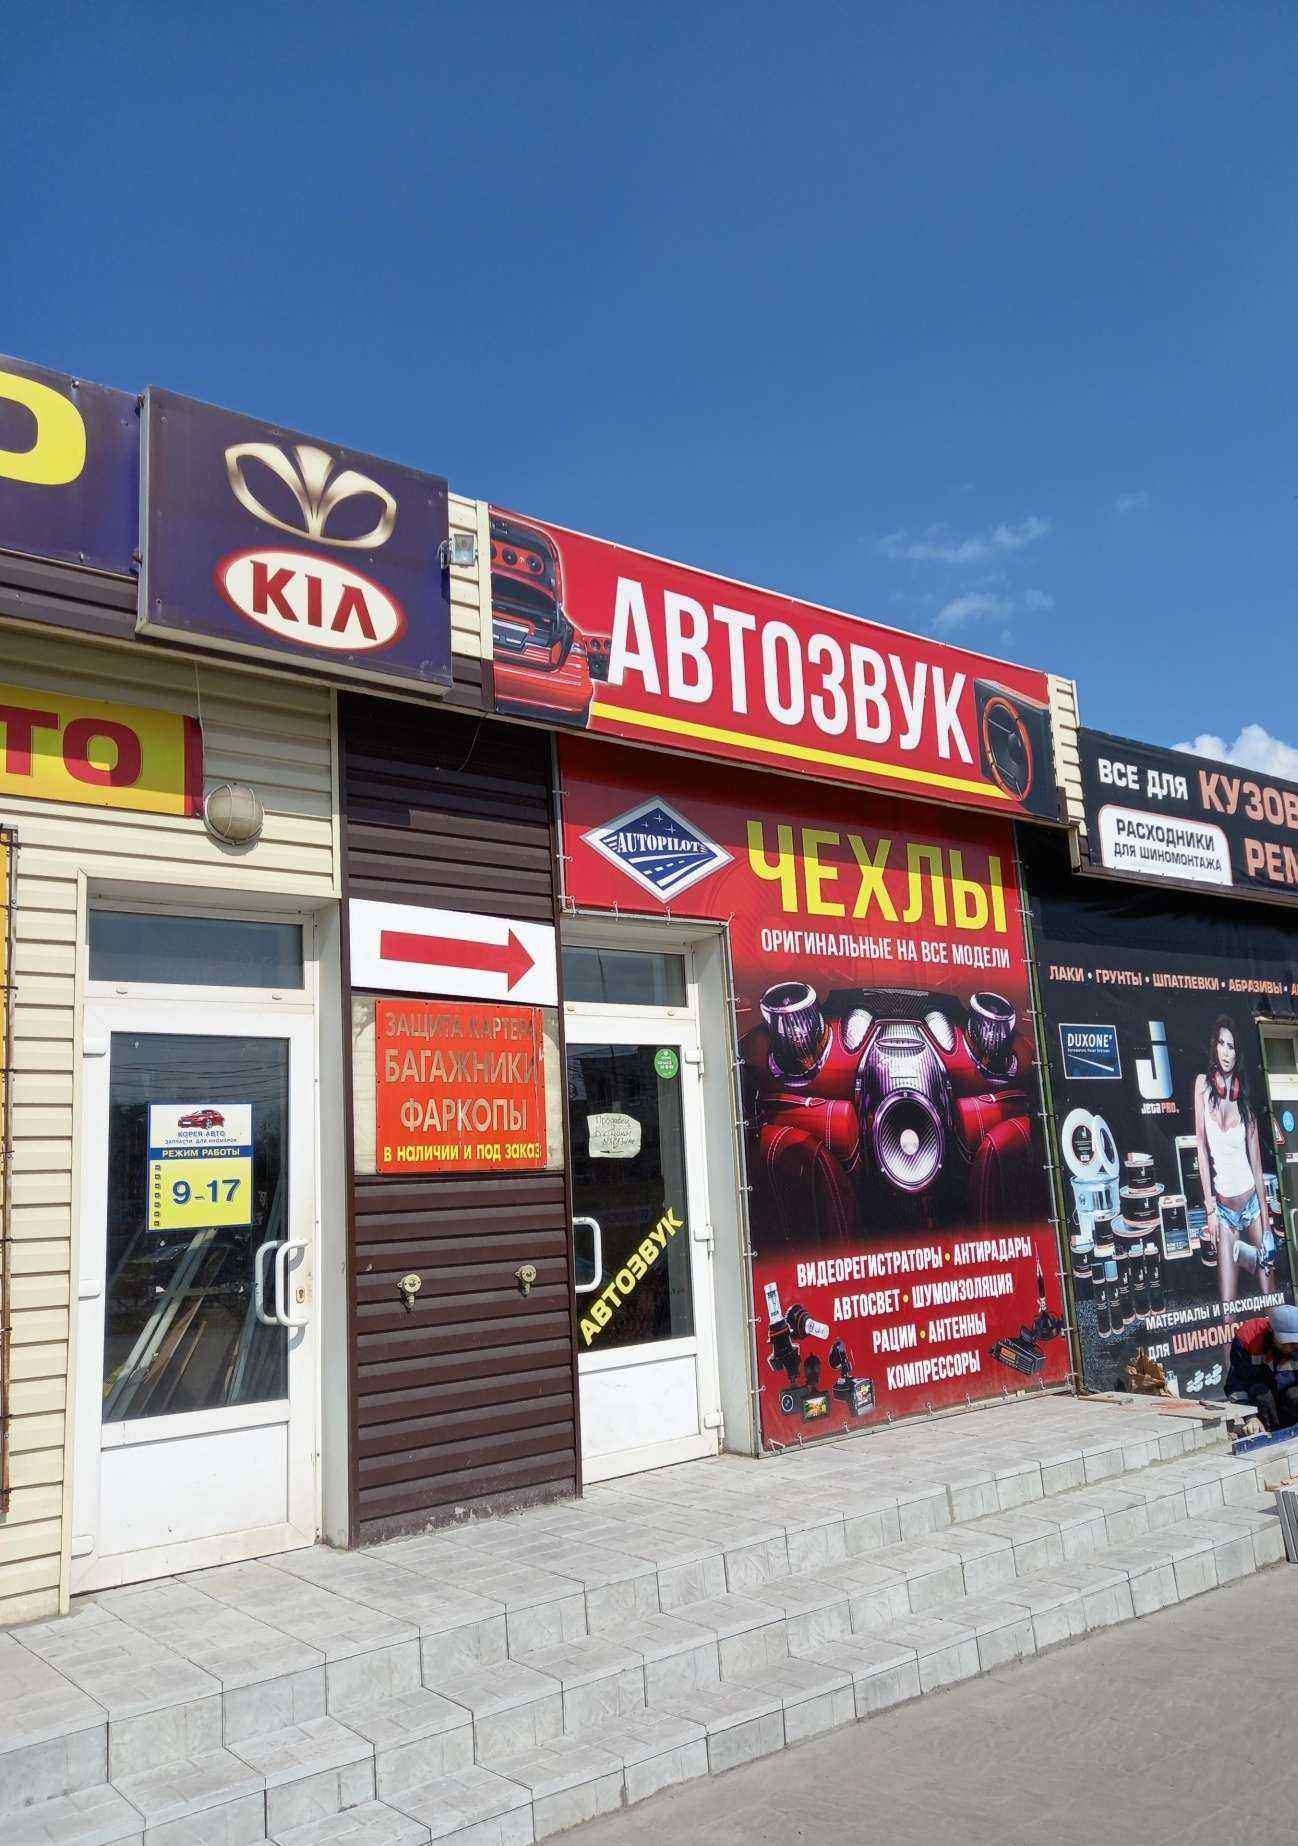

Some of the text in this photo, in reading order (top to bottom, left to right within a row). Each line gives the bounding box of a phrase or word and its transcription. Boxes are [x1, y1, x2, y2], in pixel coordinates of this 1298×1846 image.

[250, 560, 378, 641] KIA
[606, 576, 975, 765] АВТОЗВУК
[1098, 757, 1140, 790] ВСЕ
[1147, 768, 1189, 801] ДЛЯ
[618, 831, 700, 854] AUTOPILOT
[1115, 817, 1216, 852] РАСХОДНИКИ
[1114, 842, 1222, 872] ДЛЯ ШИНОМОНТАЖА
[745, 820, 1008, 933] ЧЕХЛЫ
[760, 929, 1011, 969] ОРИГИНАЛЬНЫЕ НА ВСЕ МОДЕЛИ
[1049, 965, 1085, 982] ЛАКИ
[1095, 969, 1142, 986] ГРУНТЫ
[1152, 973, 1220, 991] ШПАТЛЕВКИ
[1228, 979, 1283, 995] АБРАЗИВЫ
[385, 1011, 464, 1042] ЗАЩИТА
[385, 1048, 538, 1084] БАГАЖНИКИ
[399, 1097, 528, 1133] ФАРКОПЫ
[206, 1130, 226, 1138] АВТО
[383, 1146, 392, 1162] в
[397, 1144, 460, 1162] наличии
[464, 1144, 472, 1160] и
[477, 1143, 502, 1162] под
[162, 1148, 240, 1158] РЕЖИМ РАБОТЫ
[578, 1206, 685, 1346] АВТОЗВУК
[796, 1235, 1033, 1289] ВИДЕОРЕГИСТРАТОРЫ АНТИРАДАРЫ
[833, 1272, 1014, 1322] АВТОСВЕТ ШУМОИЗОЛЯЦИЯ
[1145, 1292, 1286, 1331] МАТЕРИАЛЫ И РАСХОДНИКИ
[872, 1311, 988, 1354] РАЦИИ АНТЕННЫ
[886, 1349, 982, 1391] КОМПРЕССОРЫ
[1148, 1342, 1171, 1362] ДЛЯ
